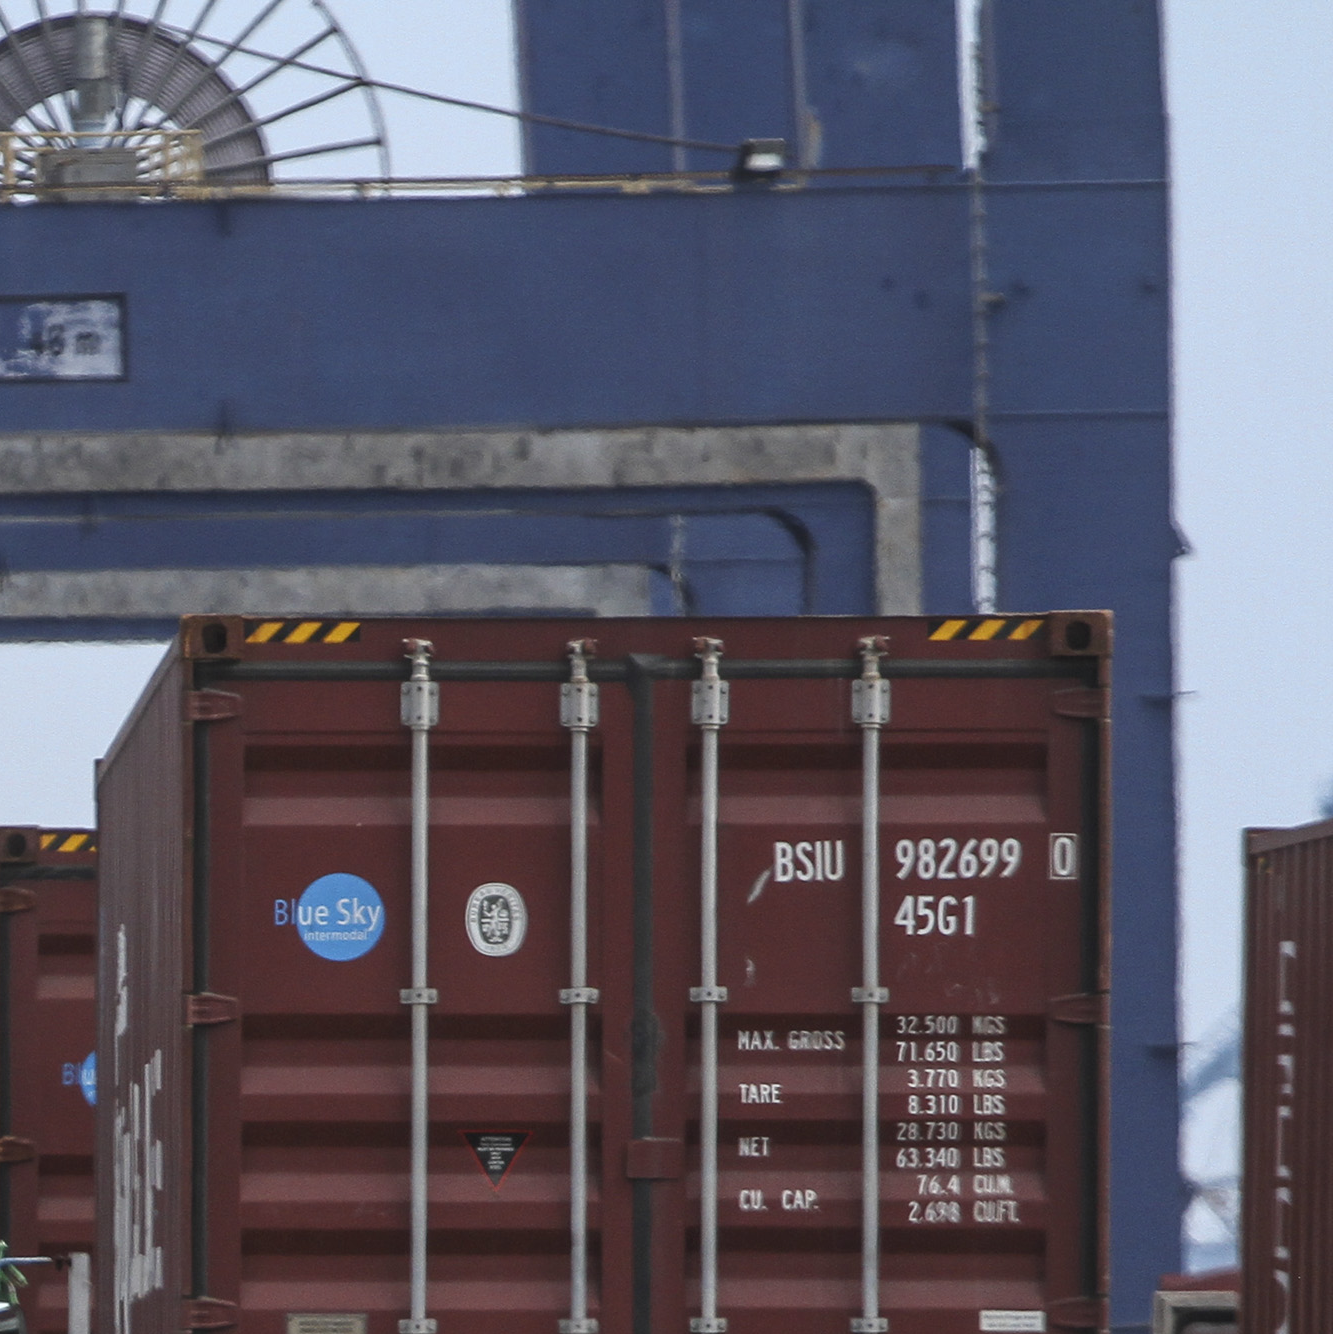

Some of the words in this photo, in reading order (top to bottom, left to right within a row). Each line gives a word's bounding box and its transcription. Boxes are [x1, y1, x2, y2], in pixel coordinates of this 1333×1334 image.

[773, 841, 845, 882] BSIU
[895, 838, 1022, 880] 982699
[274, 899, 329, 926] Blue
[336, 897, 382, 931] Sky
[894, 895, 976, 936] 45G1
[304, 929, 368, 942] intermodal
[896, 1016, 958, 1034] 32.500
[972, 1016, 1007, 1034] KGS
[738, 1030, 781, 1050] MAX.
[787, 1030, 845, 1050] GROSS
[896, 1041, 959, 1062] 71.650
[972, 1041, 1005, 1062] LBS
[907, 1069, 959, 1088] 3.770
[972, 1069, 1006, 1088] KGS
[739, 1083, 782, 1104] TARE
[907, 1095, 960, 1115] 8.310
[973, 1095, 1006, 1115] LBS
[897, 1122, 960, 1141] 28.730
[974, 1122, 1007, 1141] KGS
[739, 1137, 769, 1157] NET
[896, 1147, 960, 1168] 63.340
[973, 1147, 1005, 1168] LBS
[917, 1174, 961, 1195] 76.4
[739, 1190, 768, 1210] CU.
[782, 1190, 819, 1211] CAP.
